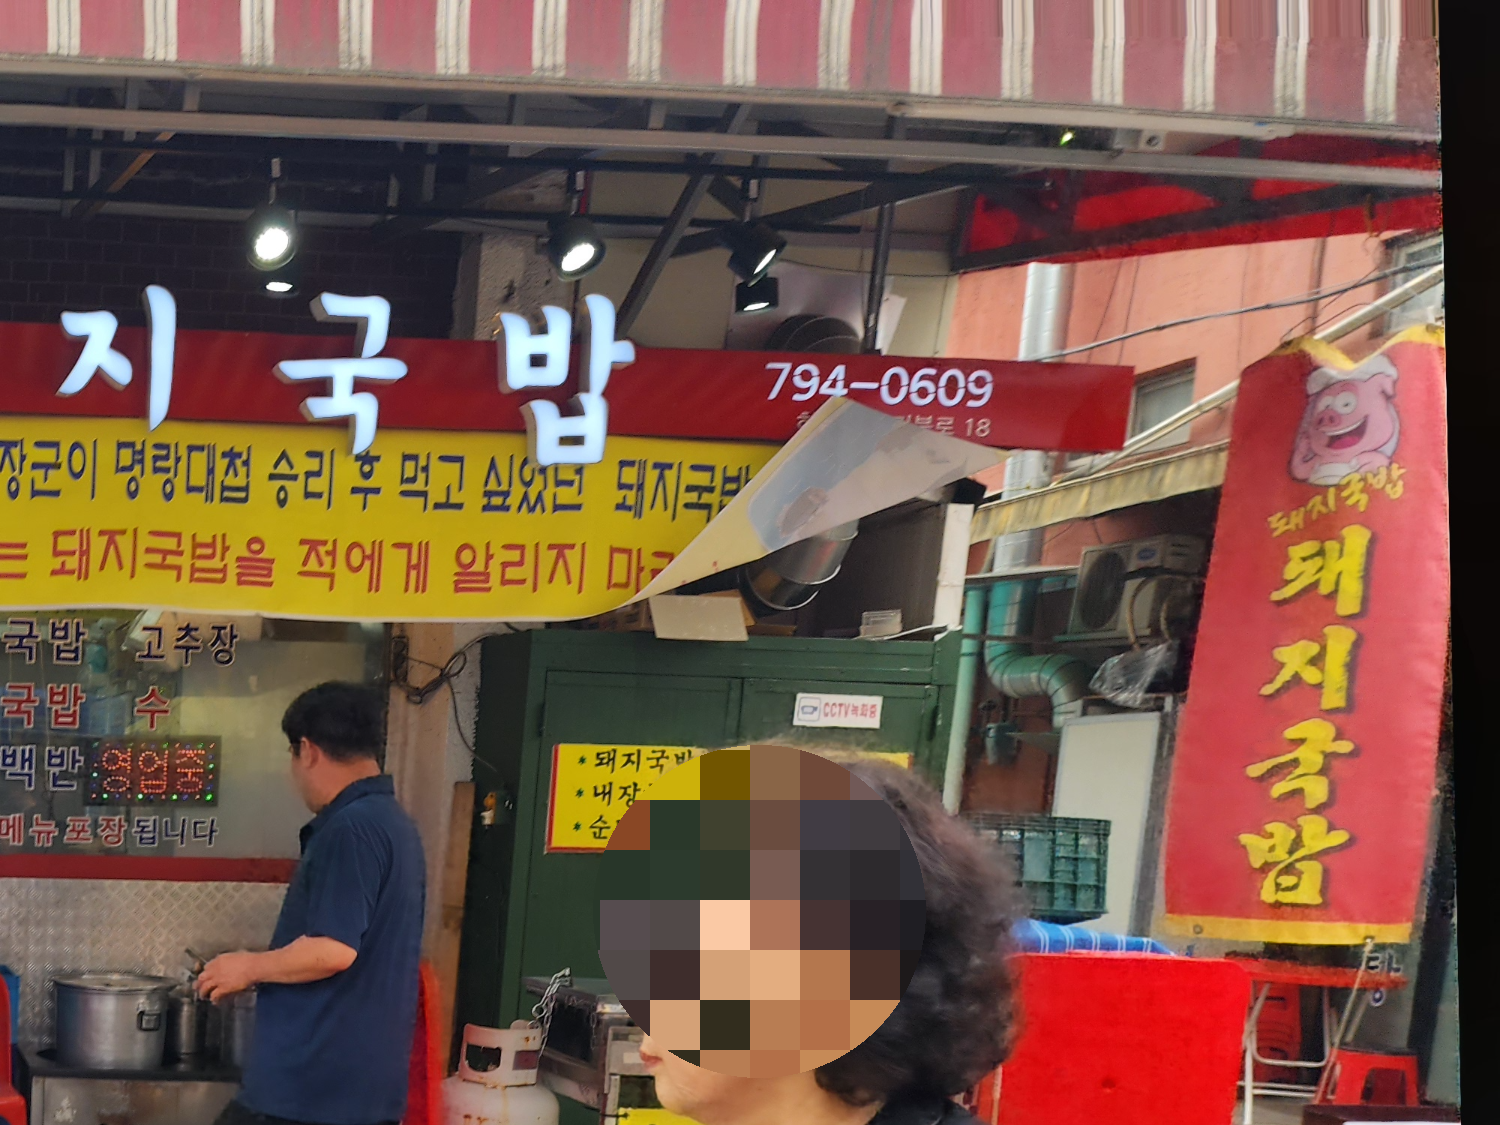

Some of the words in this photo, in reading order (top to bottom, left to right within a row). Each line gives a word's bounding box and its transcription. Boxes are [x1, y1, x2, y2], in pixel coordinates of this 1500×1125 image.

[764, 361, 994, 408] 794-0609
[965, 417, 991, 438] 18
[114, 438, 252, 505] 명랑대첩
[267, 448, 336, 511] 승리
[350, 449, 382, 513] 후
[398, 451, 466, 514] 먹고
[1266, 465, 1407, 539] 돼지국밥
[49, 526, 276, 588] 돼지국밥을
[296, 537, 430, 594] 적에게
[453, 540, 587, 595] 알리지
[135, 623, 240, 668] 고추장
[1238, 522, 1372, 906] 돼지국밥
[101, 747, 206, 794] 영업중
